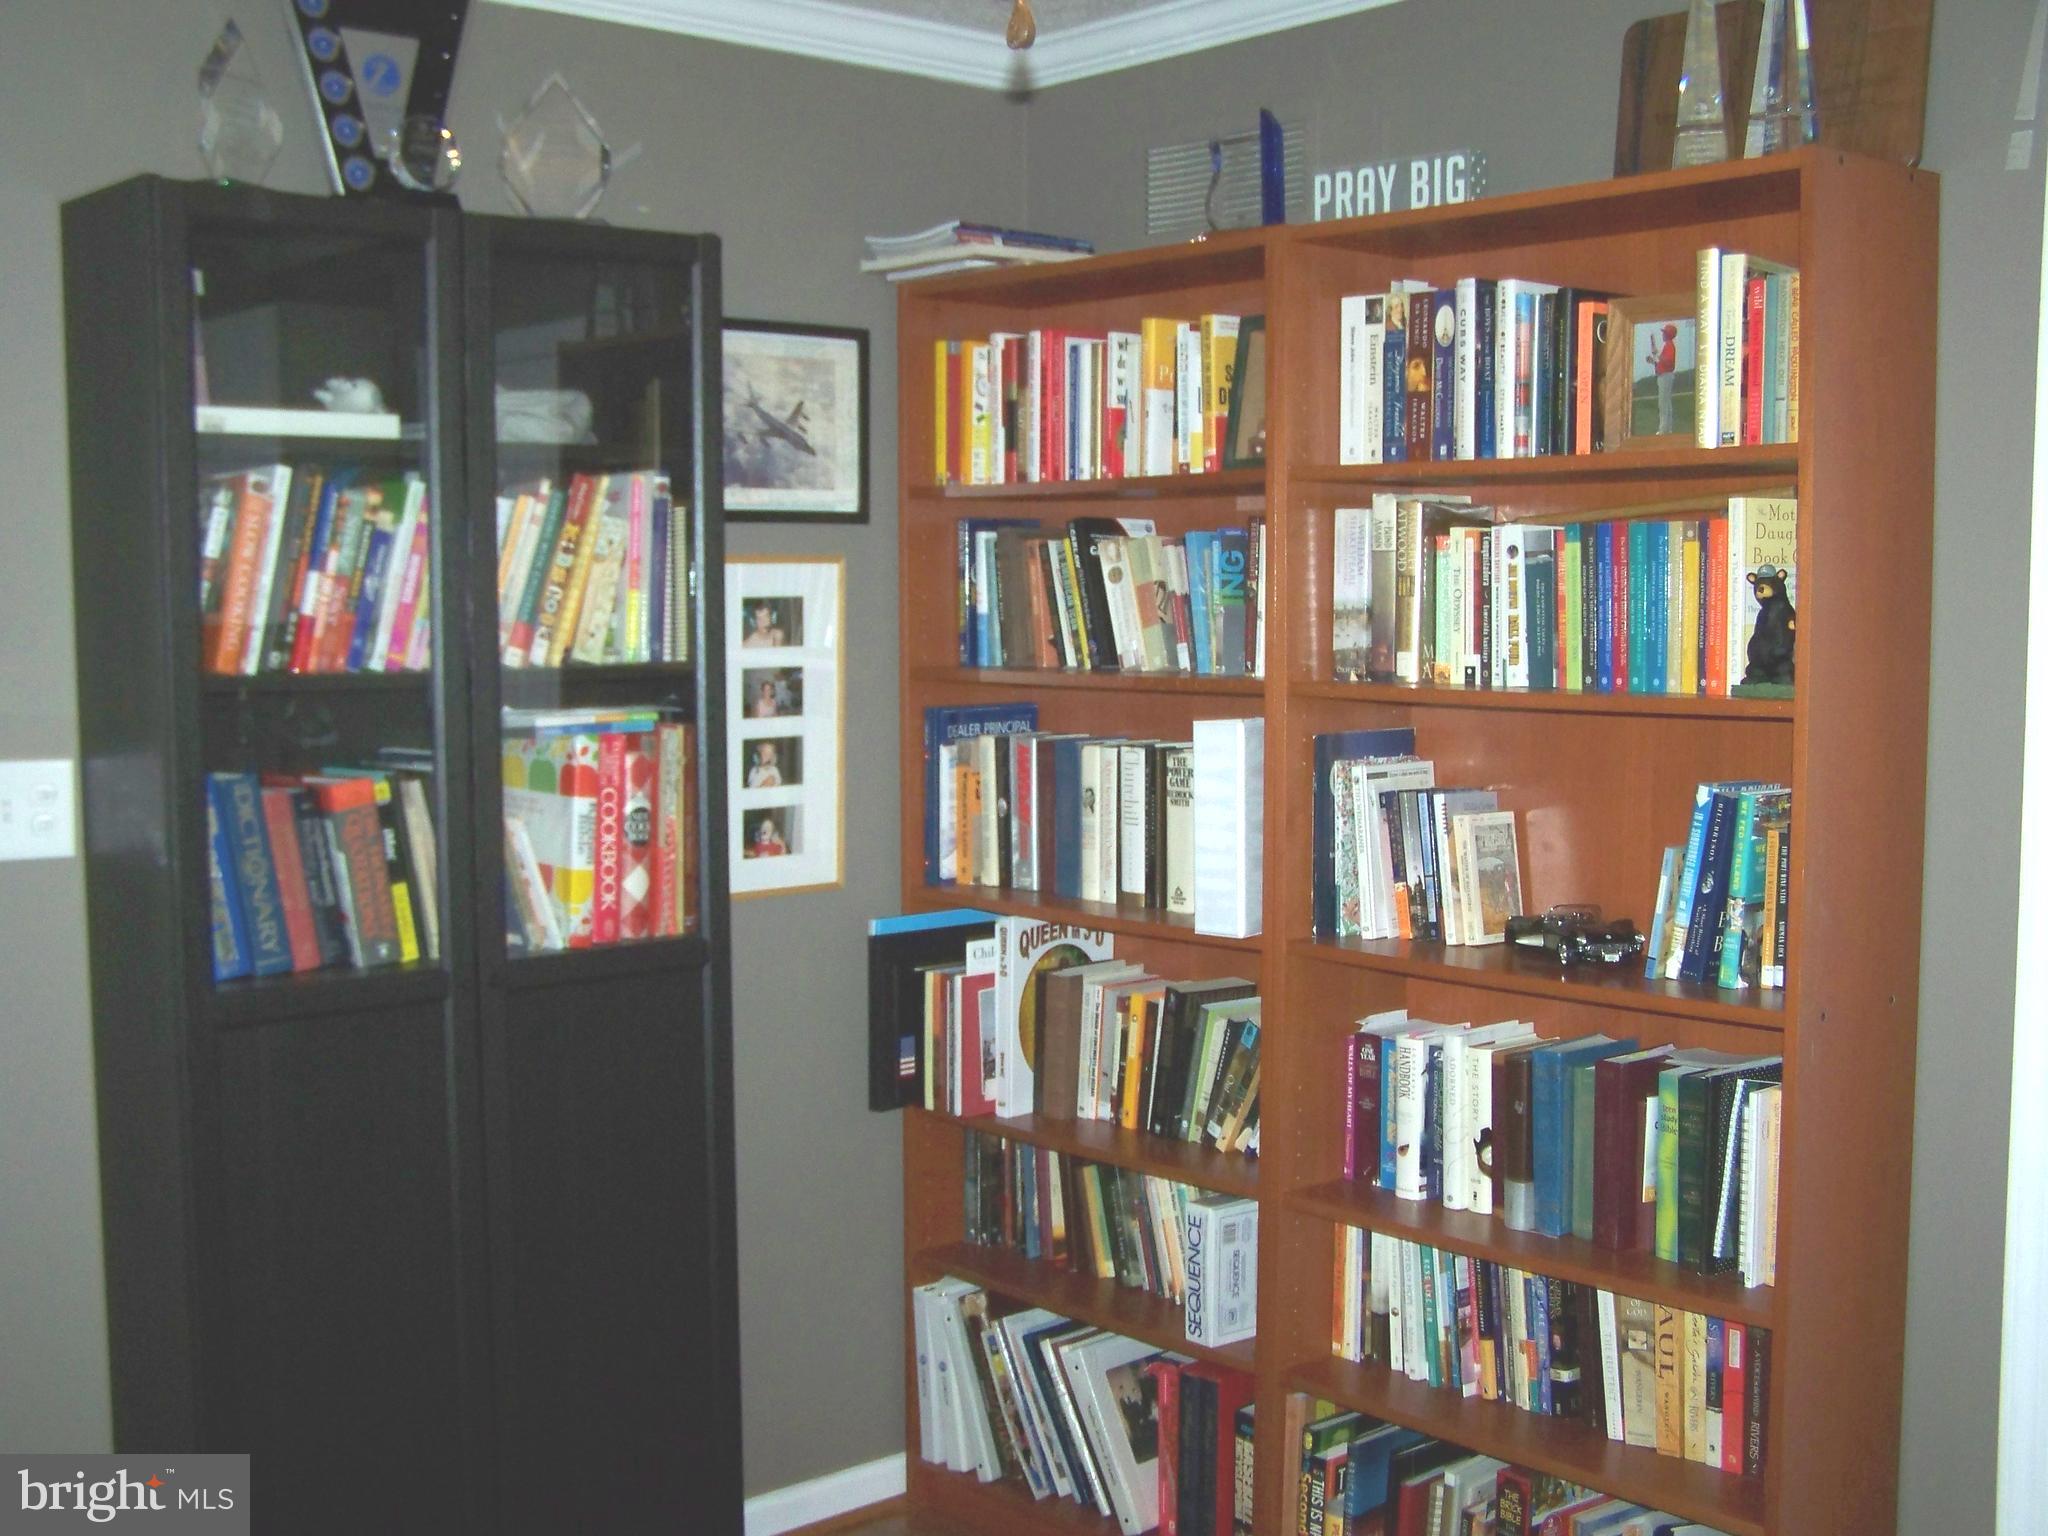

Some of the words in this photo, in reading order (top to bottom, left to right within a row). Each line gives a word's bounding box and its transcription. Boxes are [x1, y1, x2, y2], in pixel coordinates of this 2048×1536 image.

[1314, 164, 1396, 222] PRAY
[1410, 154, 1465, 210] BIG
[1699, 258, 1710, 290] FIND
[1459, 308, 1467, 348] CUBS
[1699, 307, 1710, 335] WAY
[1368, 333, 1380, 386] Einstein
[1459, 354, 1467, 383] WAY
[1725, 336, 1736, 387] DREAM
[1699, 364, 1708, 406] DIANA
[1697, 410, 1707, 443] NYAD
[1768, 503, 1797, 520] Mot
[1397, 508, 1408, 572] ATWOOD
[1753, 547, 1788, 565] Book
[1481, 536, 1491, 587] Conquistadora
[1453, 588, 1462, 635] ODYSSEY
[947, 723, 981, 739] DEALER
[983, 719, 1032, 735] PRINCIPAL
[1168, 767, 1194, 779] POWER
[1172, 757, 1187, 767] THE
[1123, 749, 1140, 827] Churchill
[1170, 778, 1191, 788] GAME
[1170, 799, 1190, 808] SMITH
[1715, 802, 1724, 825] BILL
[600, 787, 618, 911] COOKBOOK
[1708, 825, 1720, 862] BRYSON
[233, 782, 281, 953] DICTIONARY
[1733, 854, 1742, 891] ISLAND
[1779, 889, 1787, 904] STAIN
[972, 946, 997, 961] Chil
[1019, 922, 1069, 960] QUEEN
[1347, 1073, 1354, 1084] OF
[1398, 1046, 1411, 1100] HANDBOOK
[1346, 1086, 1353, 1099] MY
[1187, 1213, 1203, 1338] SEQUENCE
[1232, 1249, 1241, 1298] SEQUENCE
[1657, 1304, 1674, 1380] AUL
[1749, 1421, 1760, 1460] RIVERS
[1311, 1479, 1325, 1507] THIS
[1499, 1498, 1523, 1515] BRICK
[1504, 1487, 1520, 1501] THE
[1310, 1508, 1323, 1522] IS
[1500, 1510, 1522, 1526] BIBLE
